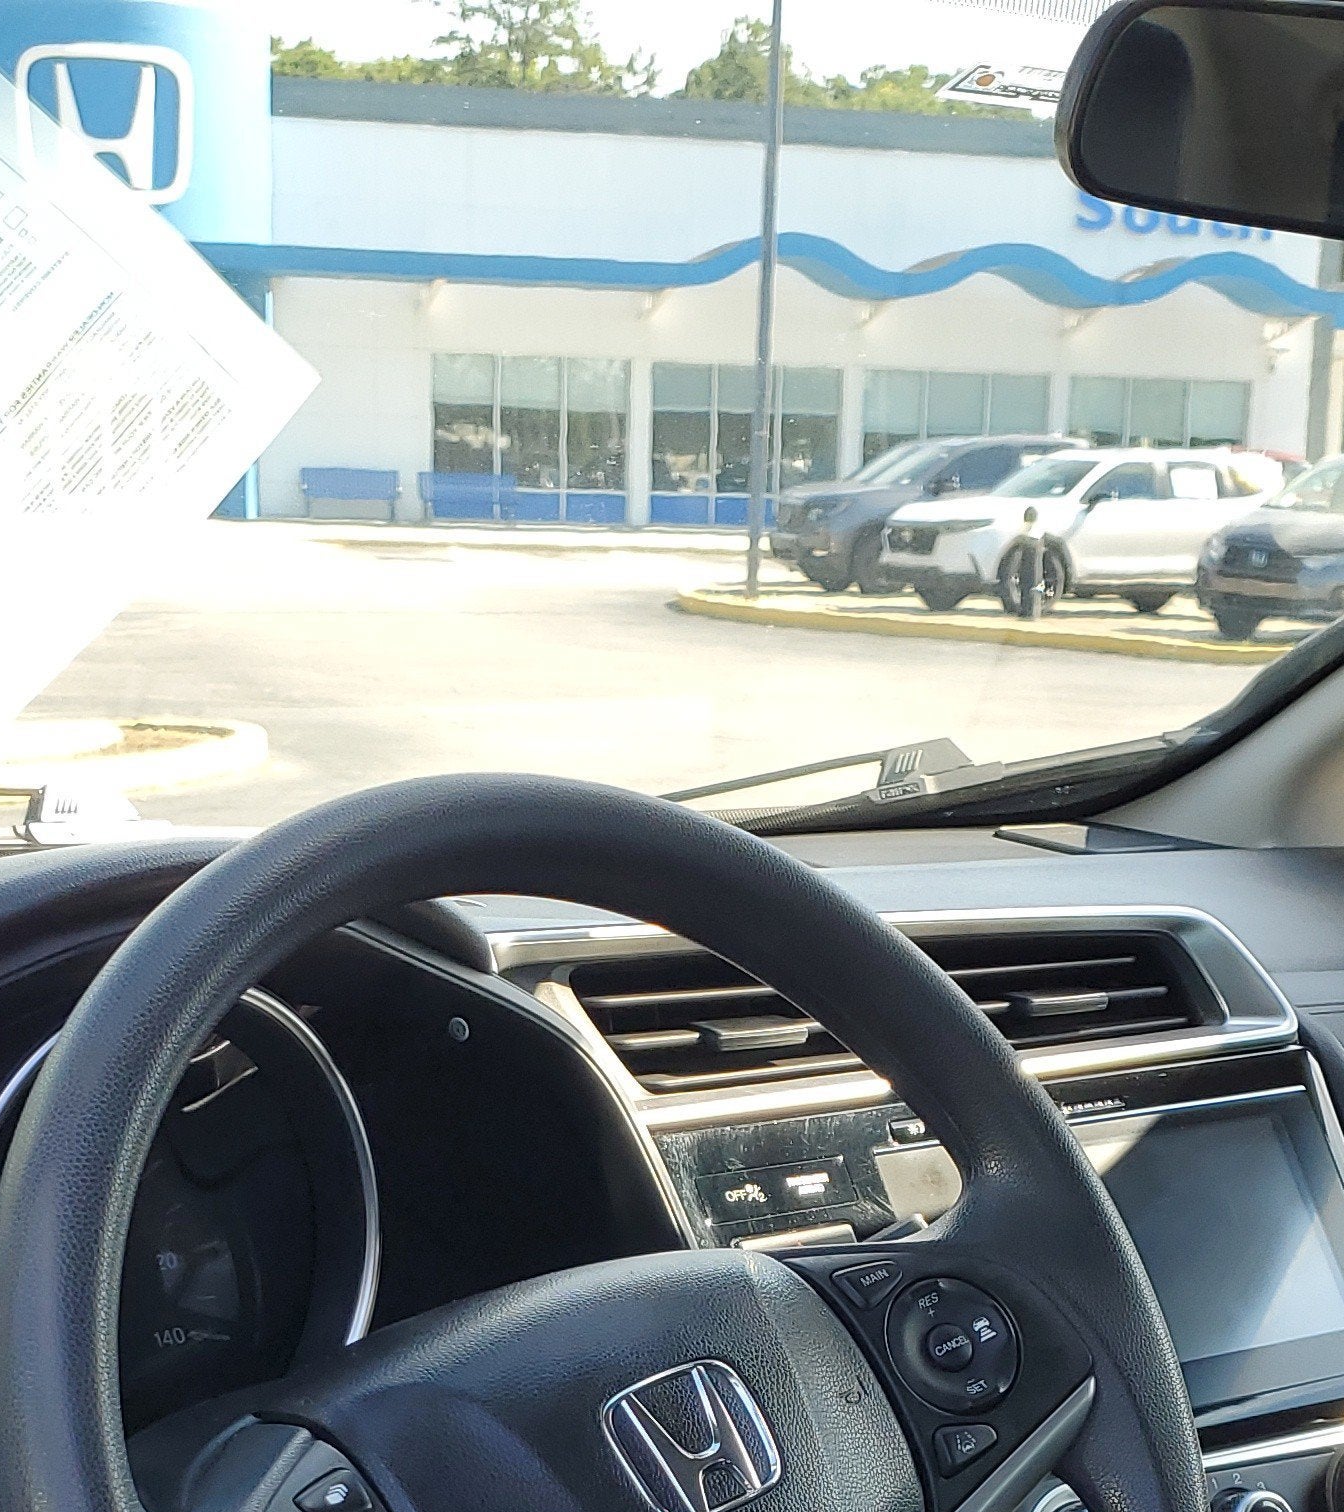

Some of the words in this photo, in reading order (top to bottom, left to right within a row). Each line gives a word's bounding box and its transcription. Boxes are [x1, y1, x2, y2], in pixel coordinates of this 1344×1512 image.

[1076, 191, 1272, 240] Sou
[860, 1268, 890, 1287] MAIN
[918, 1292, 939, 1309] RES
[935, 1335, 970, 1357] CANCEL
[966, 1379, 988, 1395] SET
